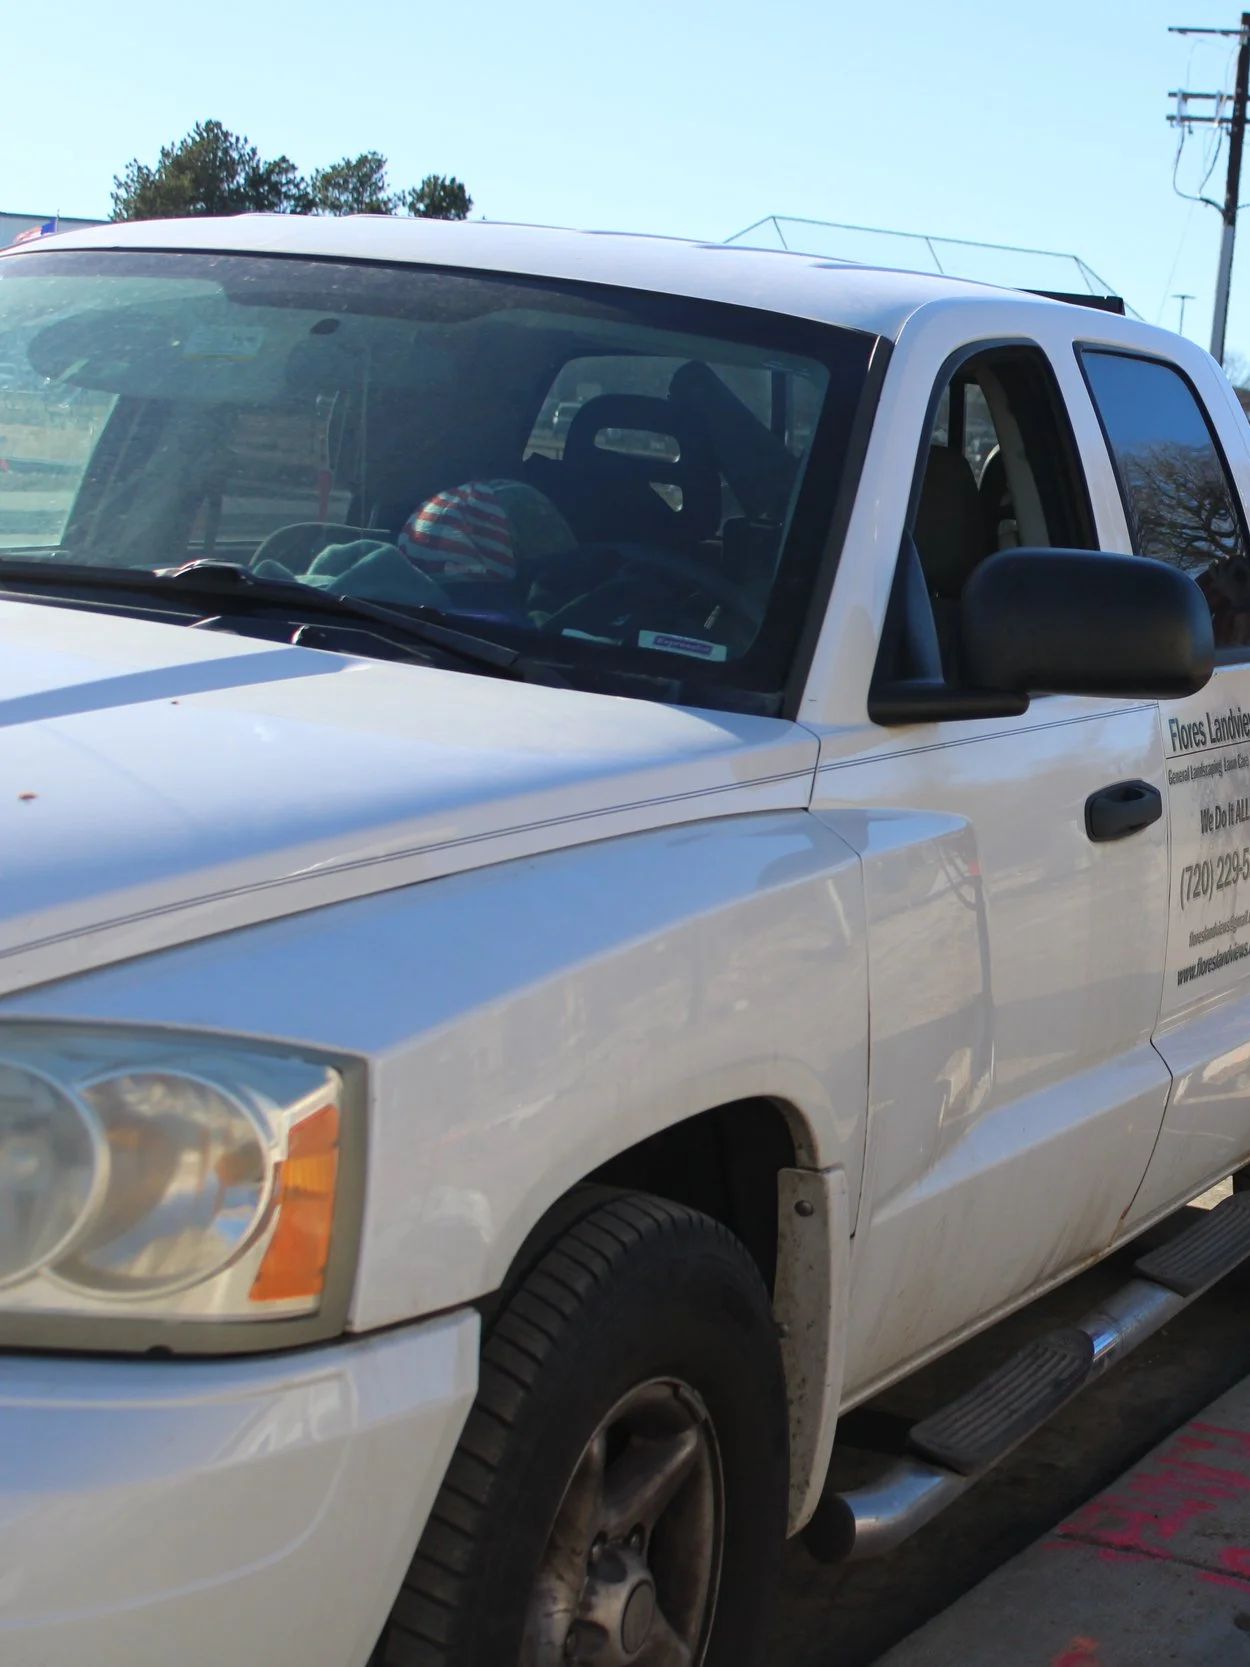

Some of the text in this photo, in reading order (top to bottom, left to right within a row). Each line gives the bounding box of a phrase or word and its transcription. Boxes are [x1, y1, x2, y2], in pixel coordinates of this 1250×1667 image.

[1168, 717, 1207, 752] Flores
[1168, 764, 1190, 785] General
[1200, 807, 1214, 835] We
[1215, 804, 1227, 830] Do
[1180, 856, 1214, 912] (720)
